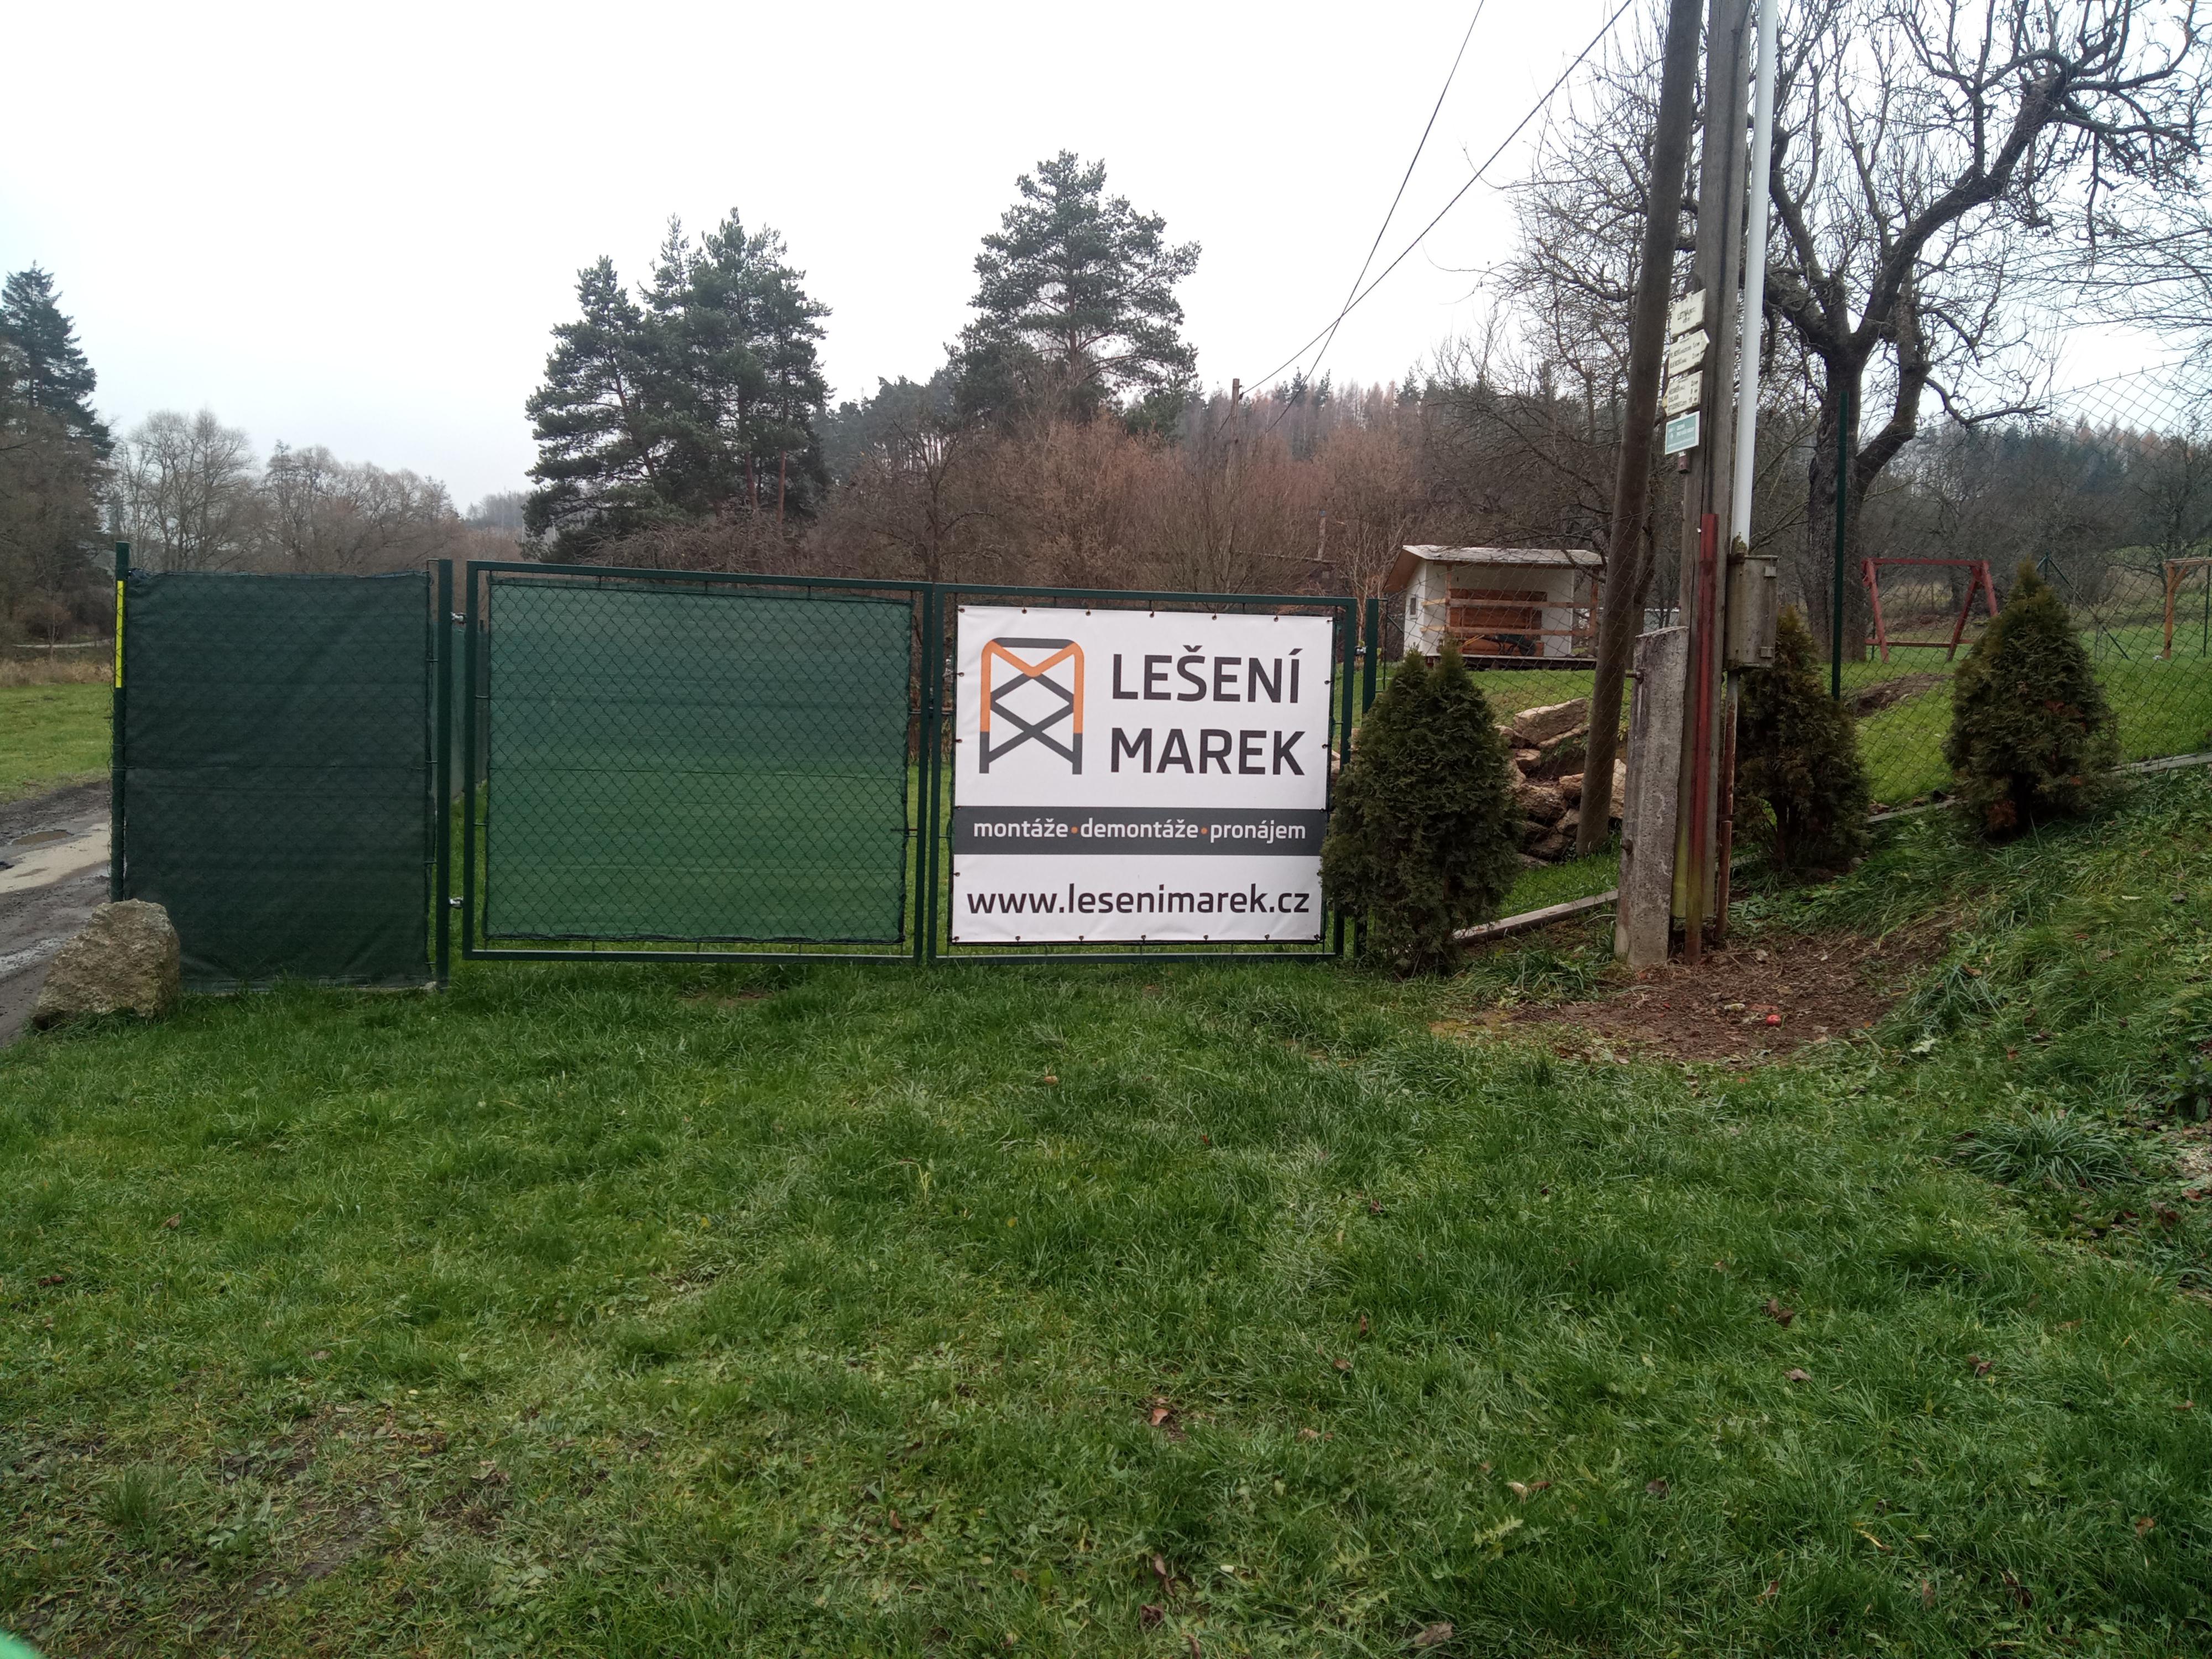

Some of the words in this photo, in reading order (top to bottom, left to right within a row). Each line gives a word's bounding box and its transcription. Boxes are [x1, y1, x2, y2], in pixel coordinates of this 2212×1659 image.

[1113, 645, 1302, 703] LEŠENÍ
[1112, 728, 1305, 775] MAREK
[974, 818, 1068, 837] montáže
[1081, 818, 1198, 838] demontáže
[1211, 820, 1305, 843] pronájem
[967, 883, 1310, 914] www.lesenimarek.cz
